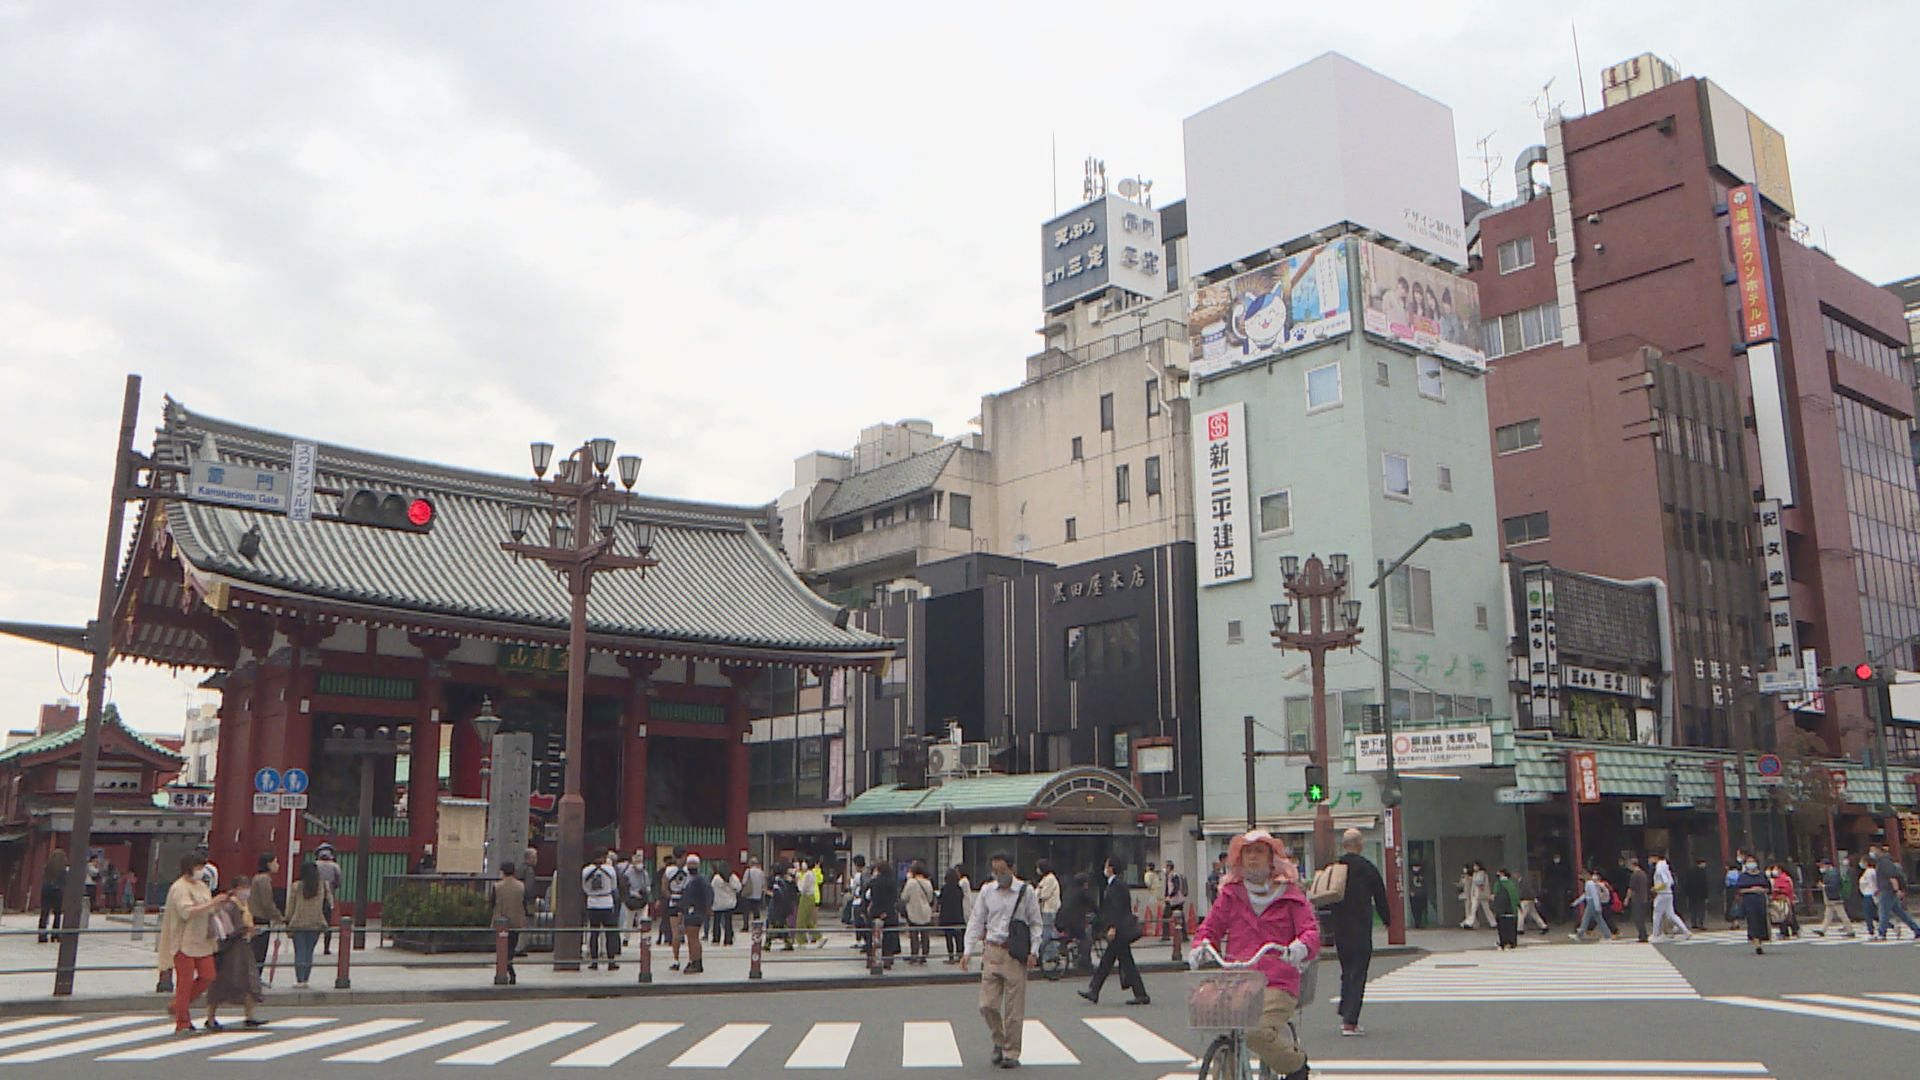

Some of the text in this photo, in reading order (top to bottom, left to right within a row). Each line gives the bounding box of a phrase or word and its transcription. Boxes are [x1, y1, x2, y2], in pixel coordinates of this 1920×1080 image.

[1749, 322, 1768, 338] 5F
[258, 493, 280, 505] Gate
[1209, 441, 1235, 578] 新三平建設
[1446, 732, 1477, 744] 浅草駅
